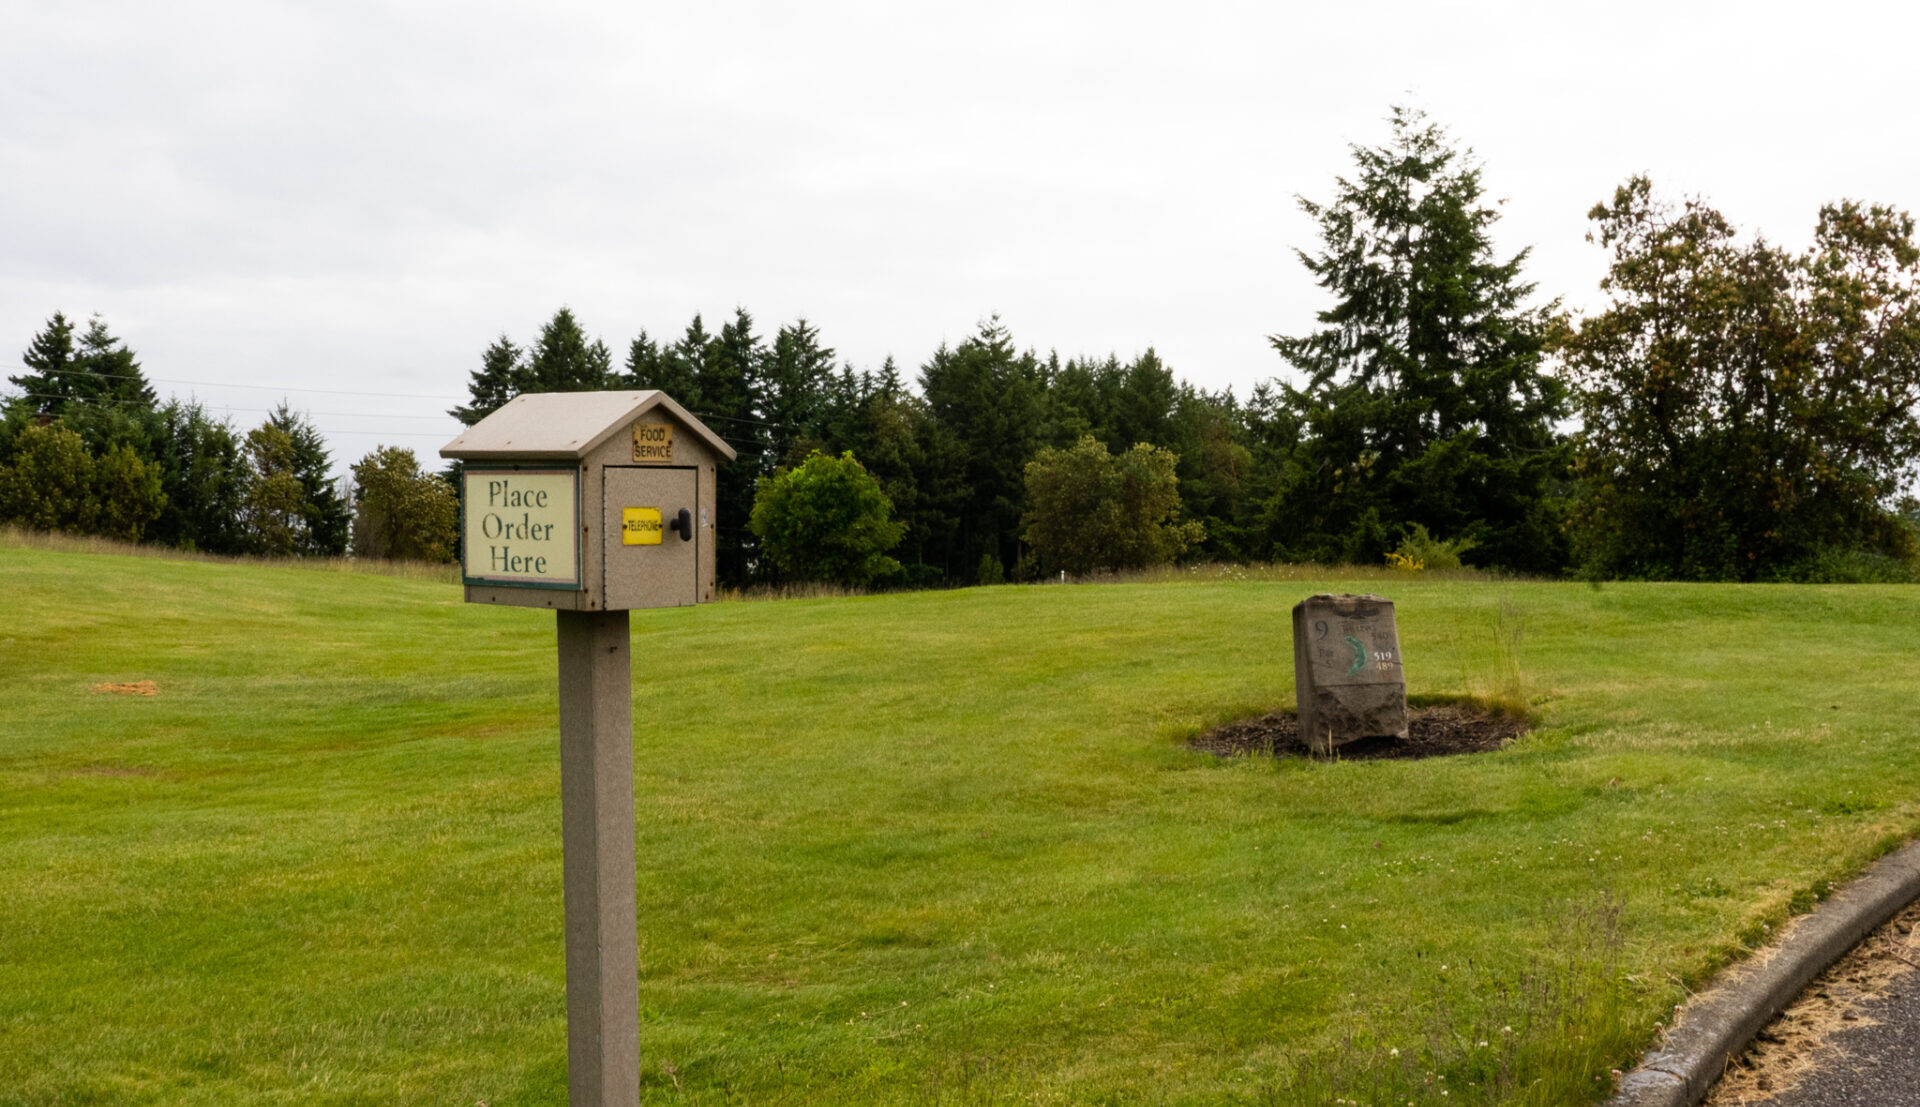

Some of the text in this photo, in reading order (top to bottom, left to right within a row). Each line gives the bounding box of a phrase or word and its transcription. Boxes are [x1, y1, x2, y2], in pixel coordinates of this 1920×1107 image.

[640, 427, 665, 441] FOOD
[634, 445, 673, 458] SERVICE
[489, 479, 548, 508] Place
[482, 512, 554, 541] Order
[628, 519, 658, 531] TELEPHONE
[490, 545, 547, 574] Here
[1314, 620, 1329, 641] 9
[1373, 651, 1392, 661] 519
